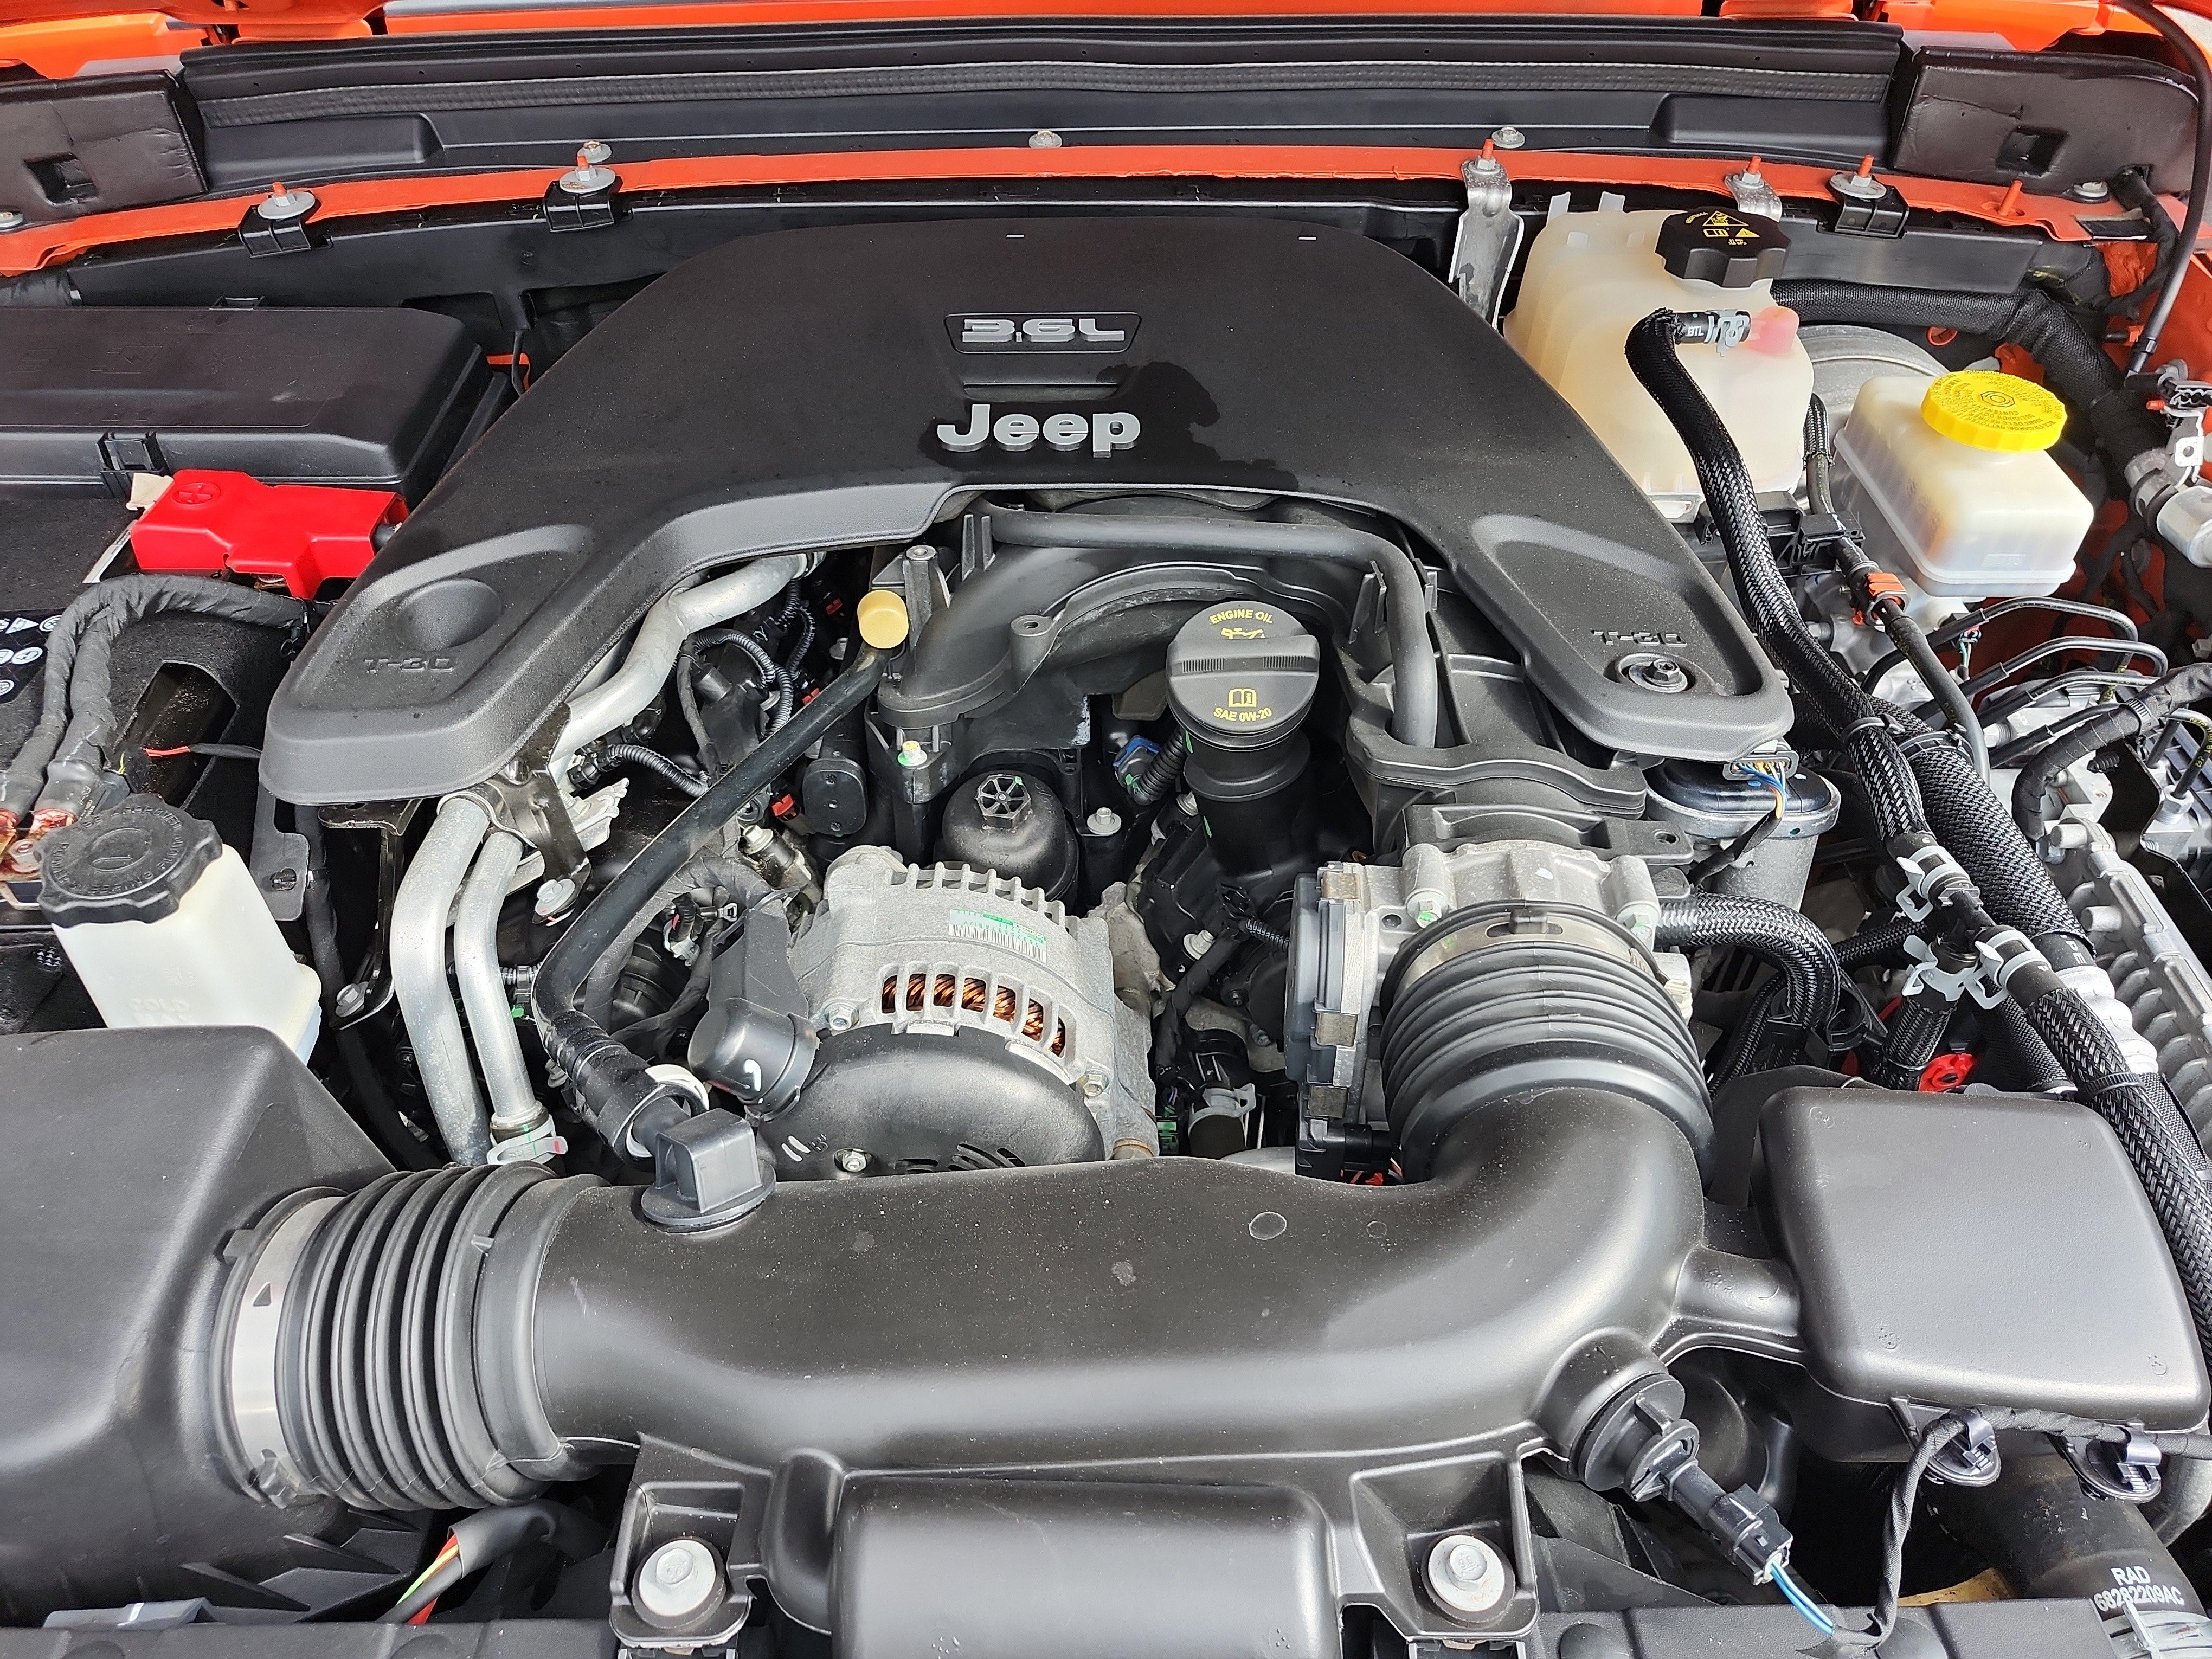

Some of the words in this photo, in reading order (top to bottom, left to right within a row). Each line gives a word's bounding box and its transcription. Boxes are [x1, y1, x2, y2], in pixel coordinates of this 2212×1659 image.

[962, 318, 1125, 343] 3.6L
[1687, 325, 1705, 337] BTL
[937, 404, 1141, 458] Jeep
[1210, 609, 1253, 624] ENGINE
[1255, 611, 1272, 624] OIL
[1213, 707, 1238, 722] SAE
[1239, 707, 1272, 722] 0W-20
[2110, 1565, 2151, 1586] RAD
[2093, 1584, 2185, 1612] 68282209AC
